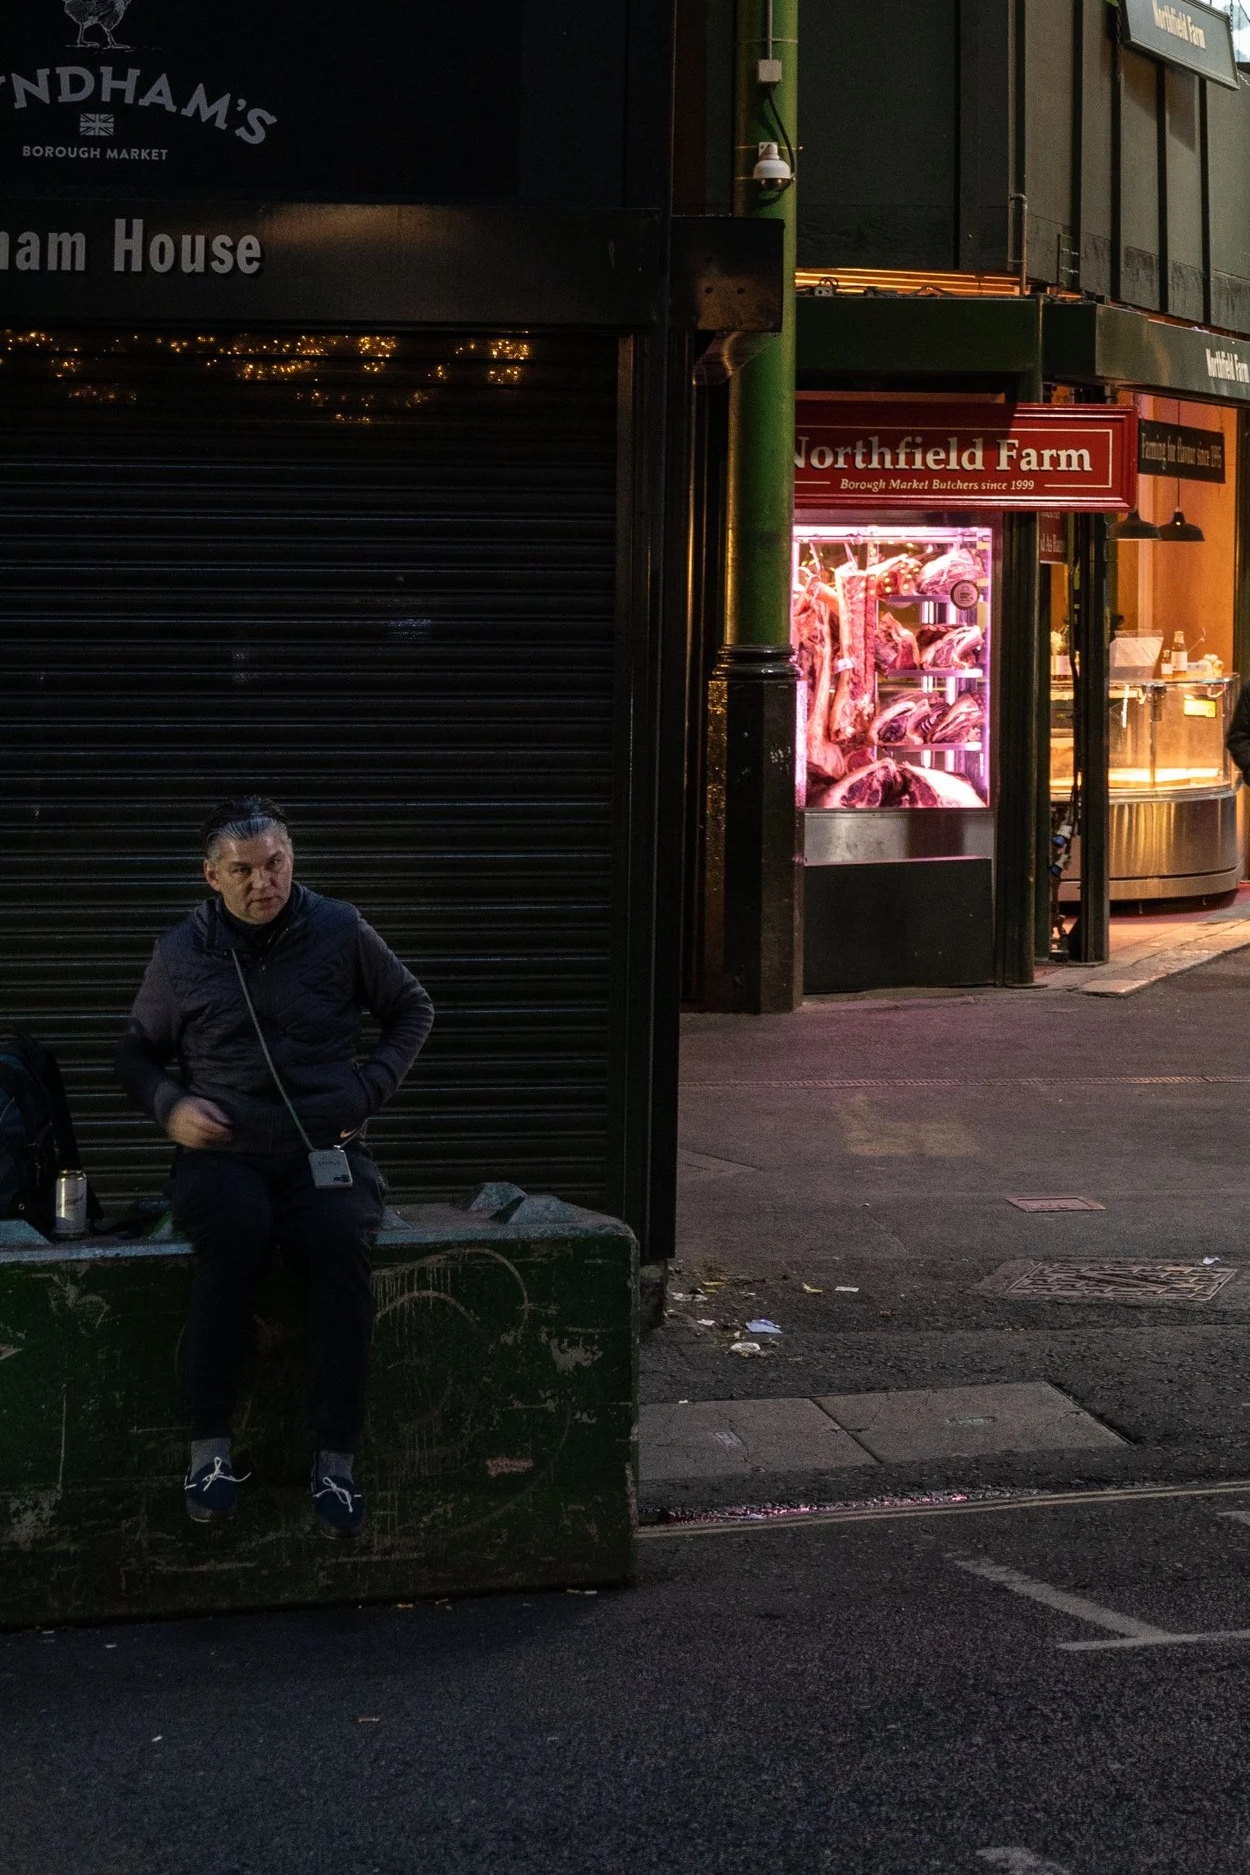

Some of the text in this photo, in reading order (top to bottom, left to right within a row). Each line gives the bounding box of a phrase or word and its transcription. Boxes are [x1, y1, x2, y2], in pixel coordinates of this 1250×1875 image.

[1187, 14, 1206, 50] Farm
[0, 65, 277, 146] NDHAM'S
[21, 145, 169, 162] BOROUGH MARKET
[113, 217, 262, 275] House
[1205, 348, 1250, 384] Northfield Farm
[995, 438, 1092, 472] Farm
[840, 478, 1035, 493] Borough Market Butchers since 1999
